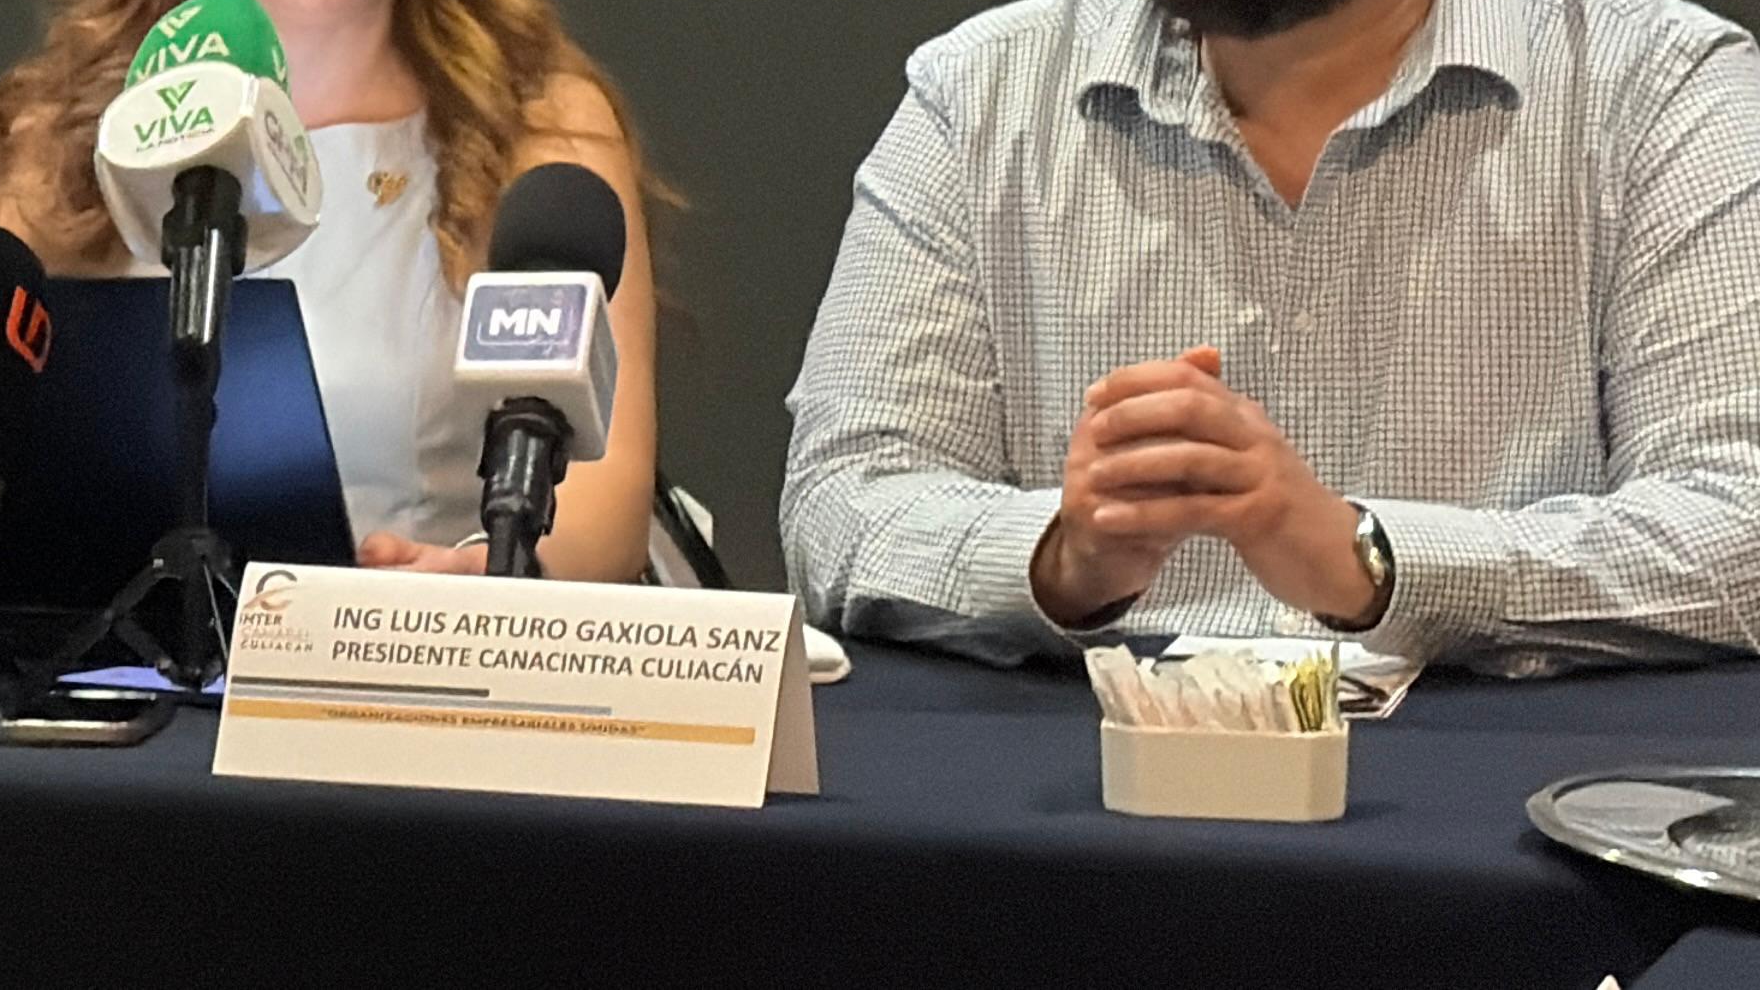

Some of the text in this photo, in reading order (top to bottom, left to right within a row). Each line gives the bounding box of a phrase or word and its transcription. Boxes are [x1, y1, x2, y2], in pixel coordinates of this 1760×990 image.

[136, 31, 230, 81] VIVA
[133, 106, 214, 143] VIVA
[488, 307, 562, 336] MN
[333, 607, 781, 652] ING LUIS ARTURO GAXIOLA SANZ
[332, 639, 764, 684] PRESIDENTE CANACINTRA CULIACÁN
